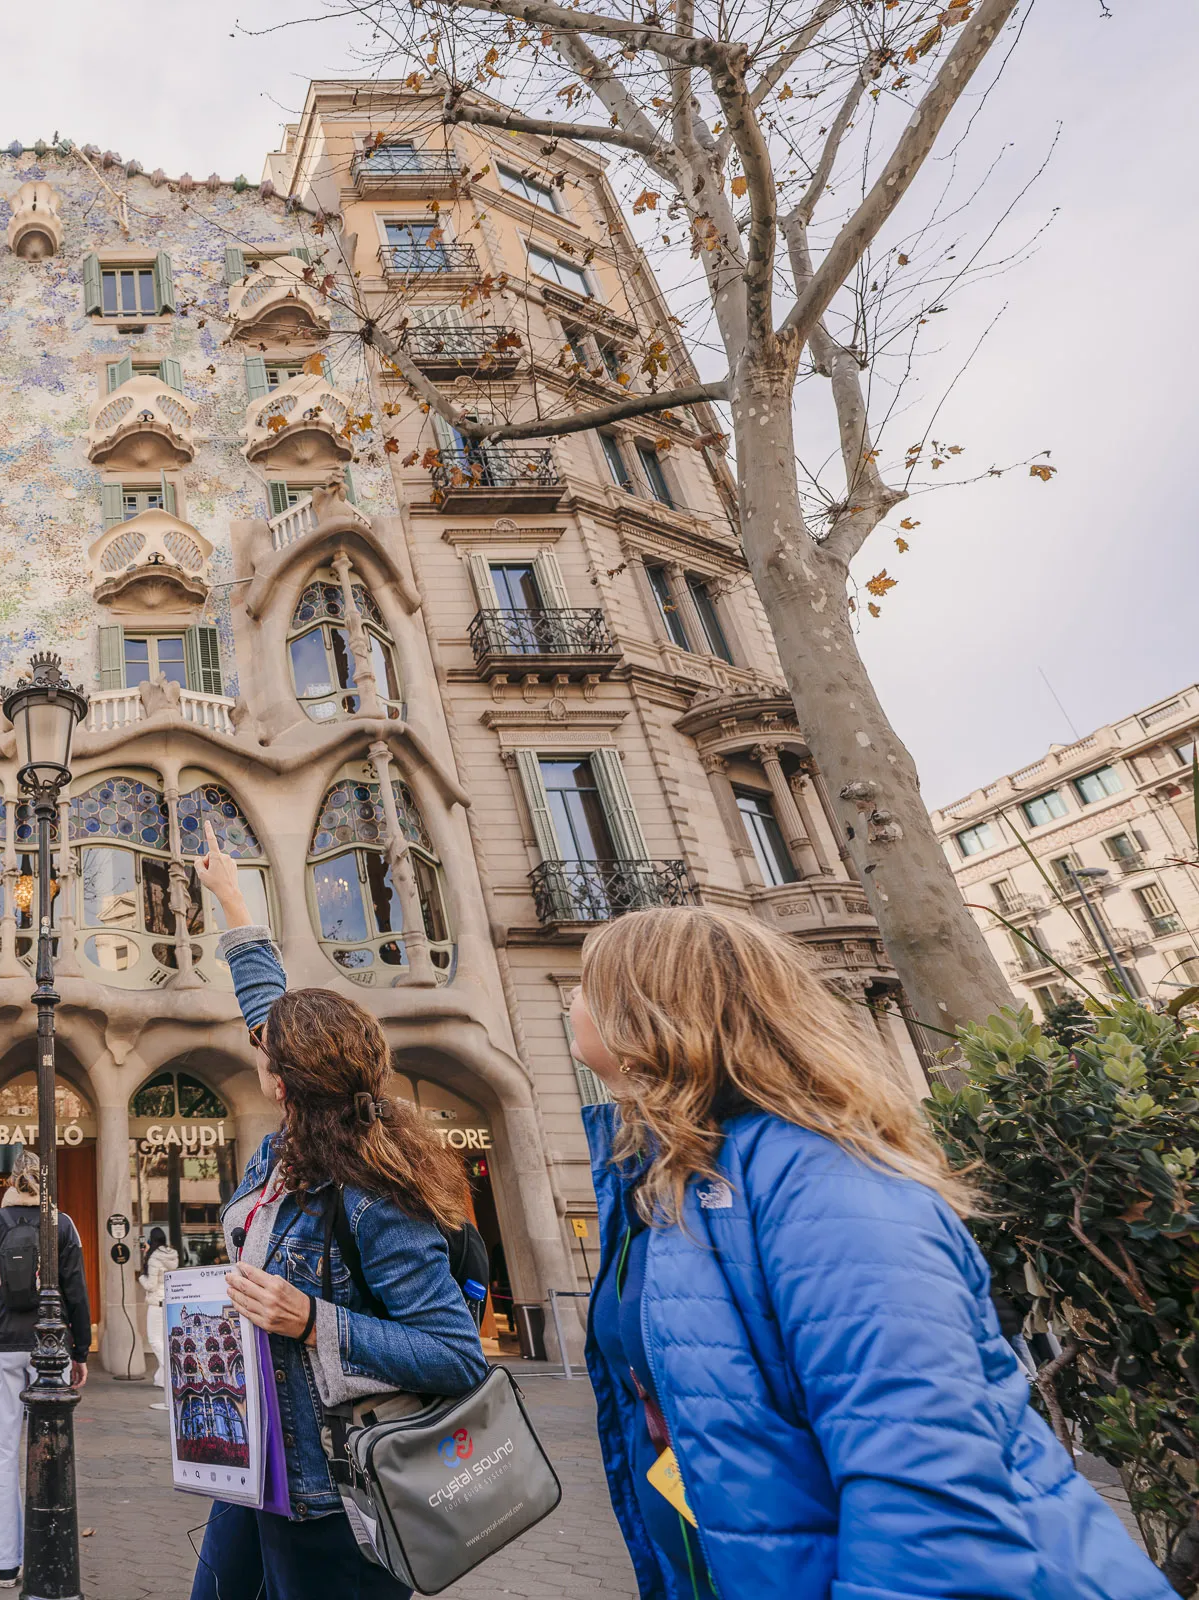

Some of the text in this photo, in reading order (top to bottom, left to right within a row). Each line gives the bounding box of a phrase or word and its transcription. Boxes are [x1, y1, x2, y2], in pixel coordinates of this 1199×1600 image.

[146, 1120, 225, 1146] GAUDÍ
[434, 1128, 493, 1149] TORE
[428, 1438, 514, 1508] crystal sound
[444, 1462, 513, 1513] tour guide systems
[465, 1502, 524, 1548] www.crystal-sound.com
